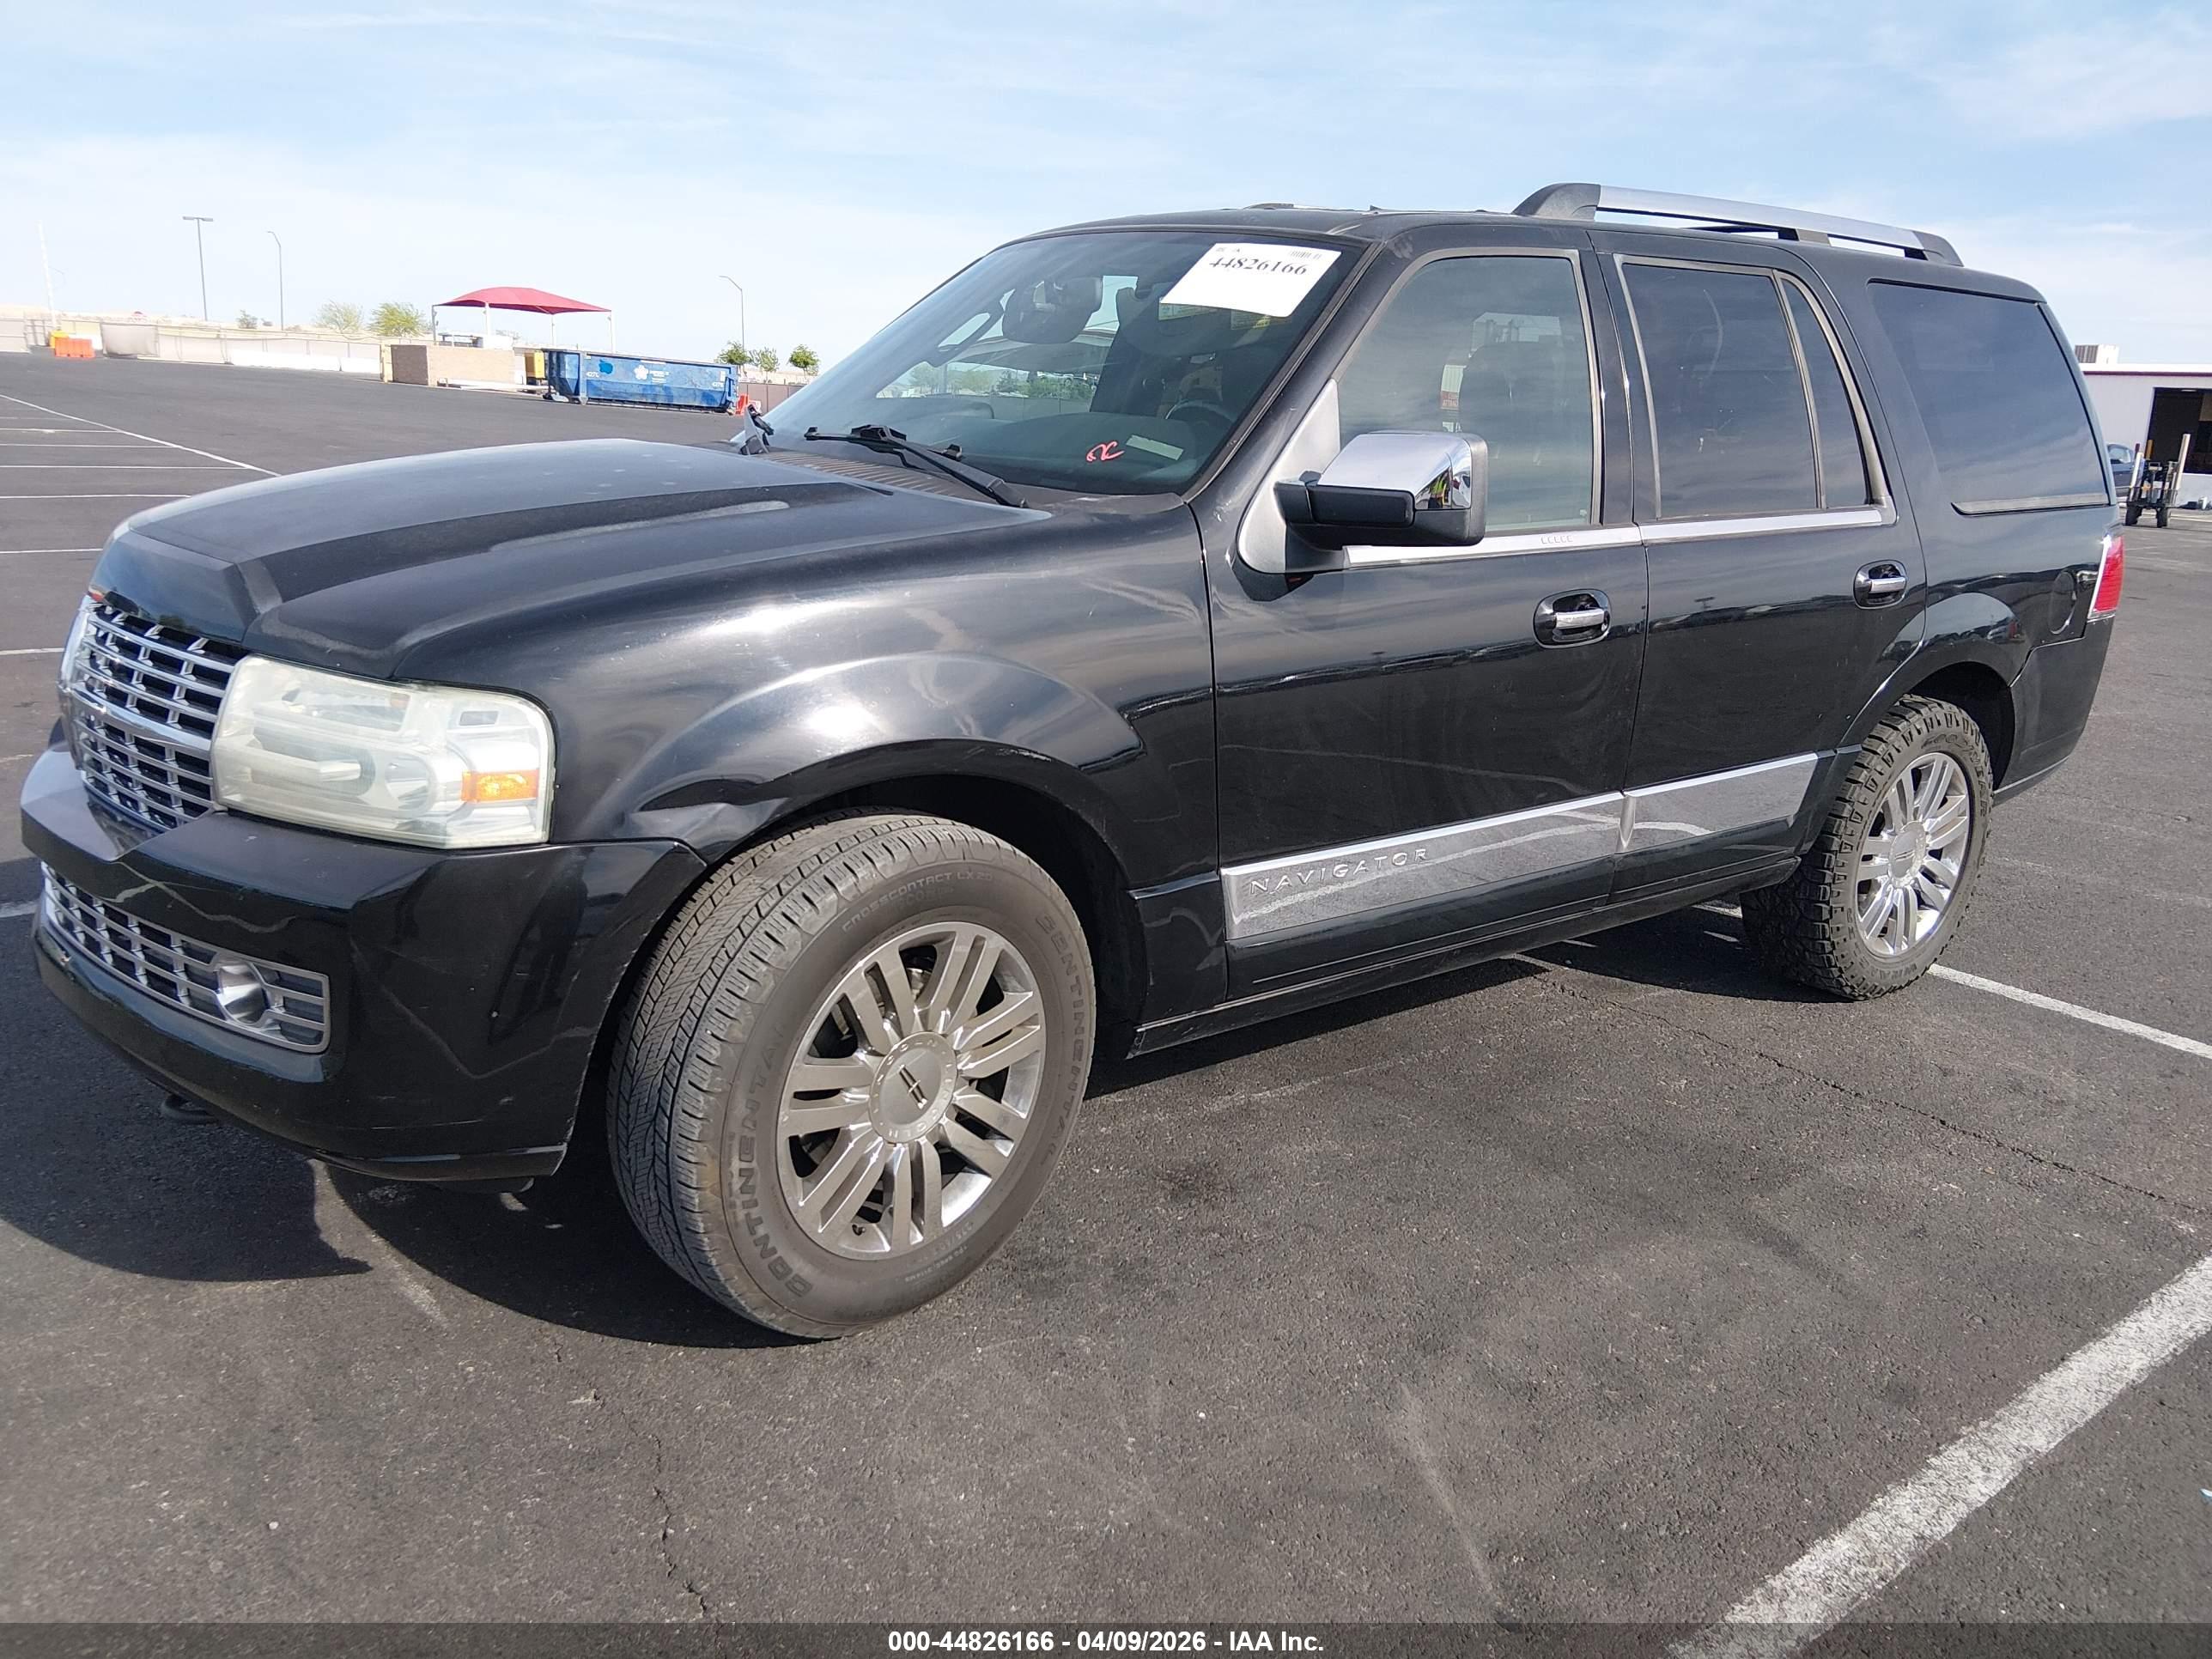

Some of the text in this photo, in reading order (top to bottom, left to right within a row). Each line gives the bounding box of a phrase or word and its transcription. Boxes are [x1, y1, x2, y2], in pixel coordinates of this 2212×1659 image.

[1209, 257, 1309, 276] 44826166
[1250, 848, 1428, 895] NAVIGATOR
[842, 872, 953, 933] CROSSCONTACT
